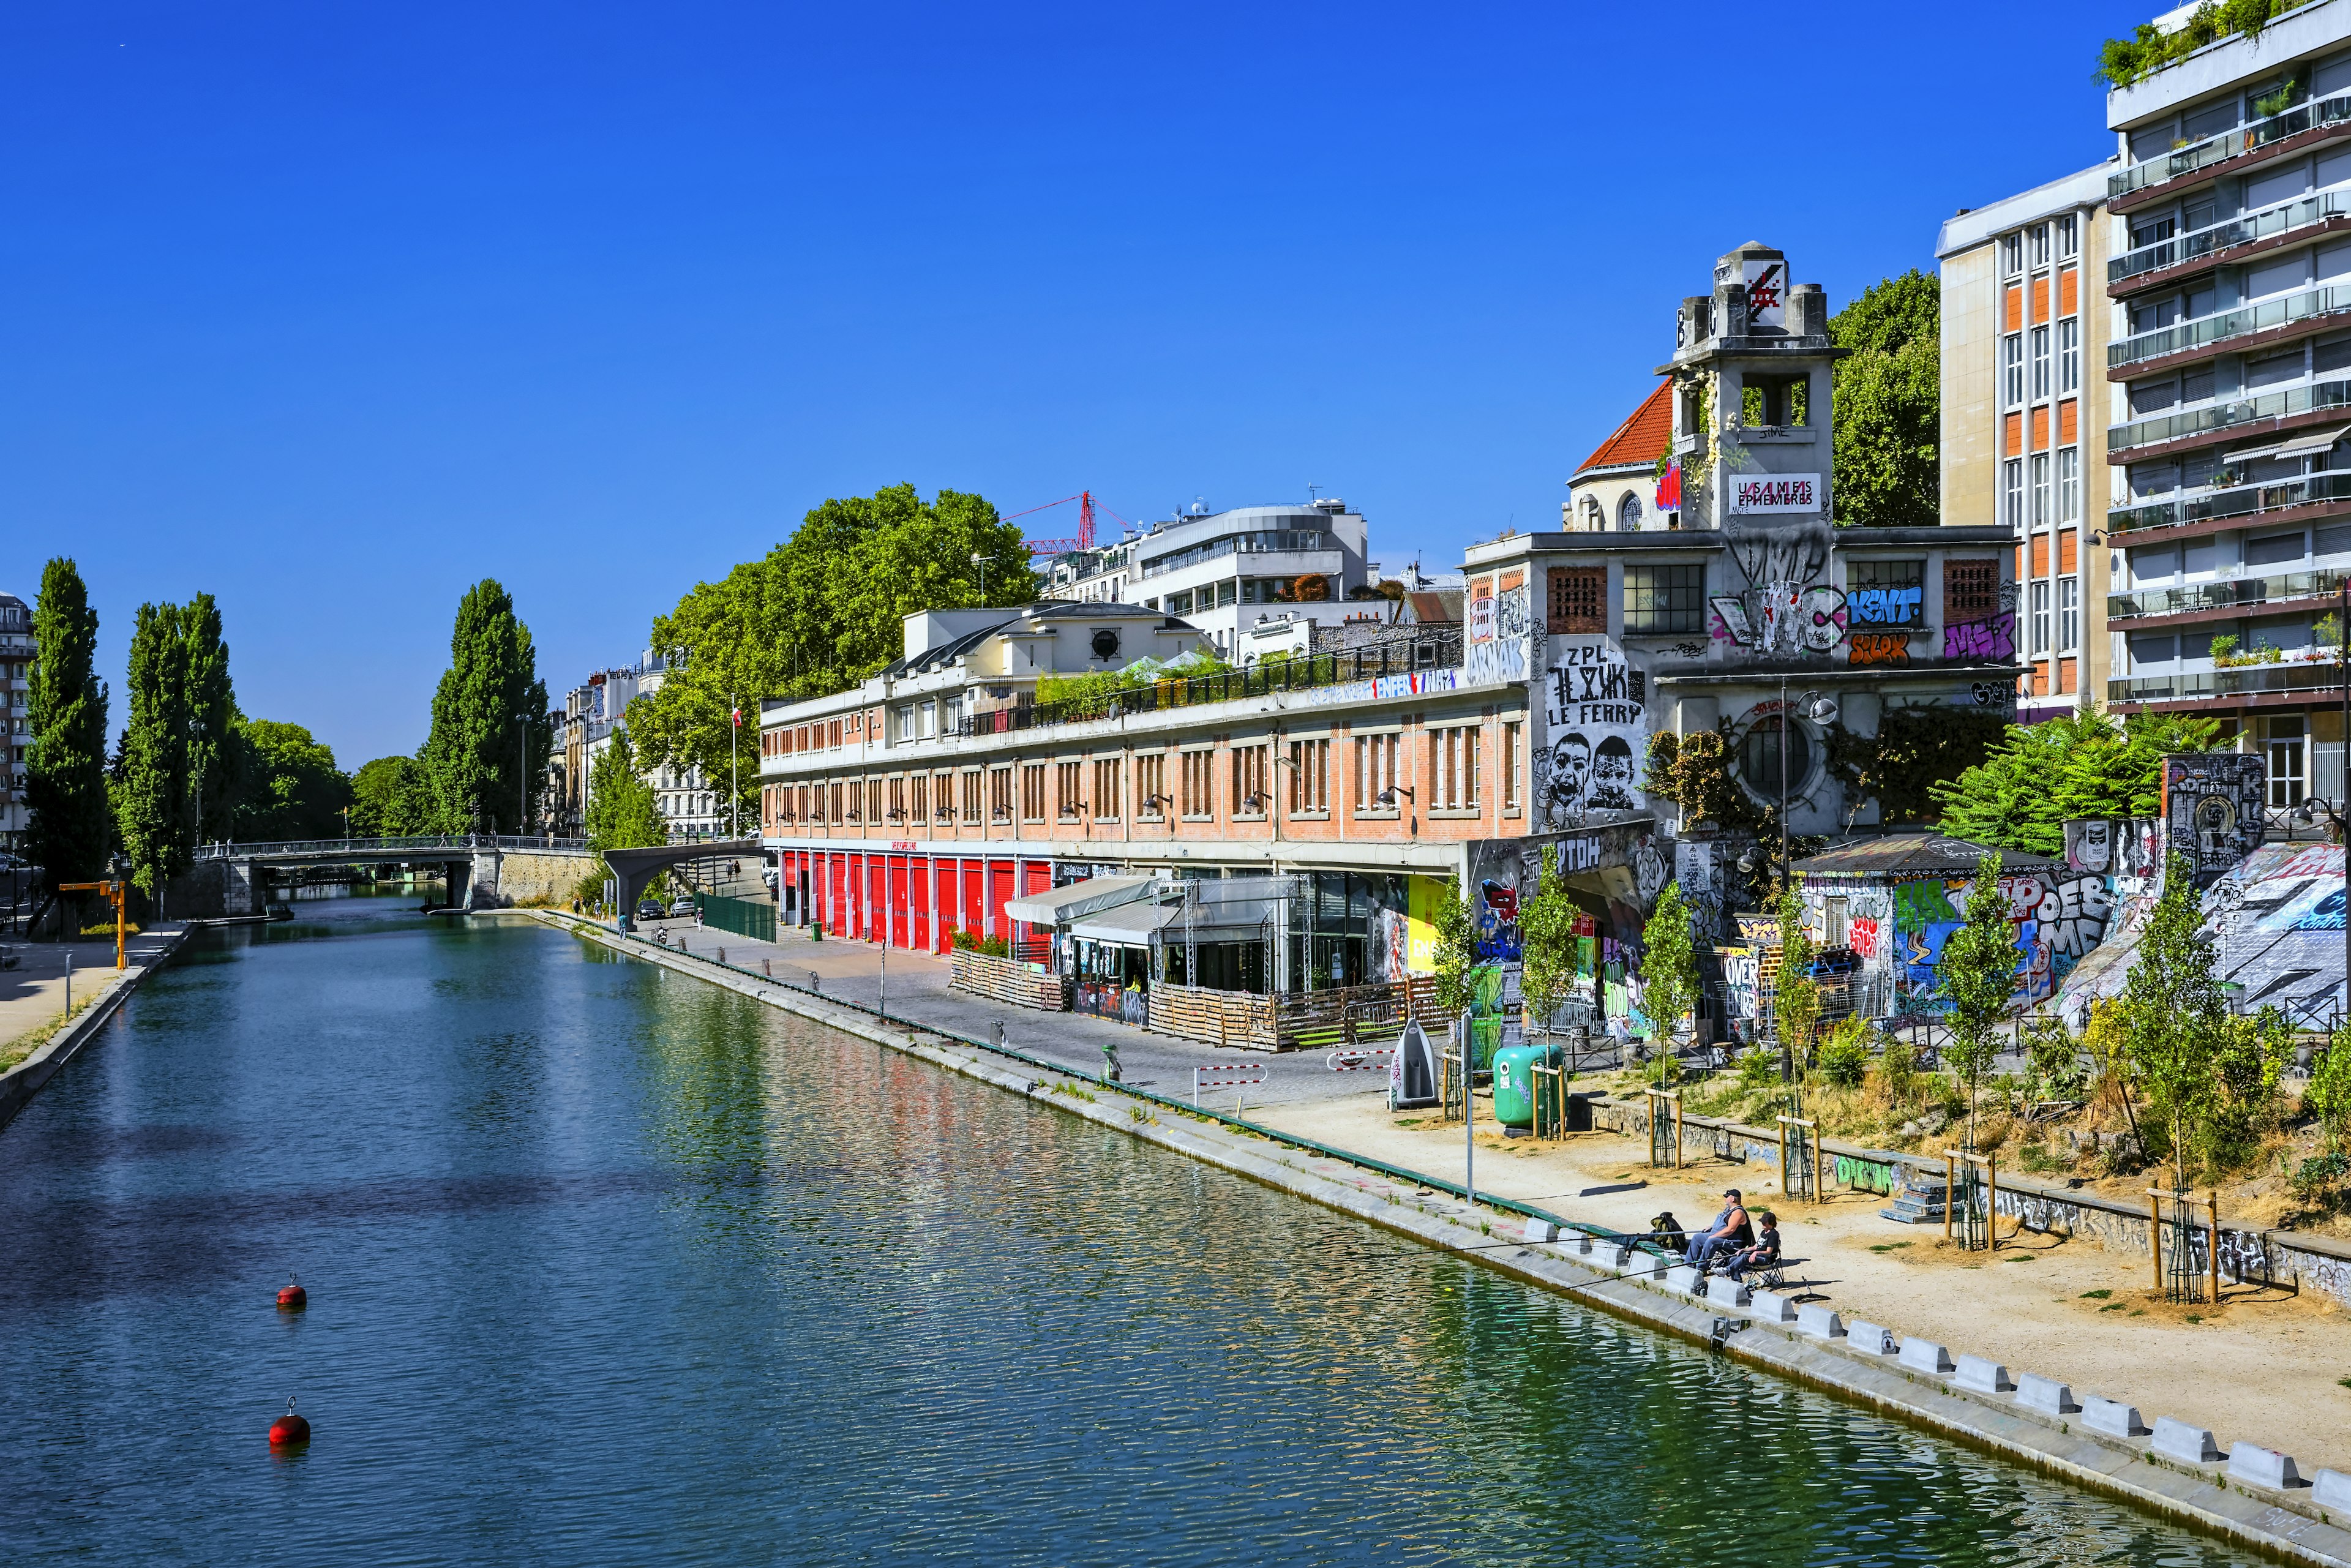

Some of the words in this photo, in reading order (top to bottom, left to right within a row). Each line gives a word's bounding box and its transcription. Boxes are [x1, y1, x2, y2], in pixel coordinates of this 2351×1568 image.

[1738, 481, 1812, 494] USINES
[1738, 493, 1812, 506] EPHEMERES
[1548, 707, 1570, 727] LE
[1580, 704, 1641, 725] FERRY
[1726, 956, 1758, 992] OVER
